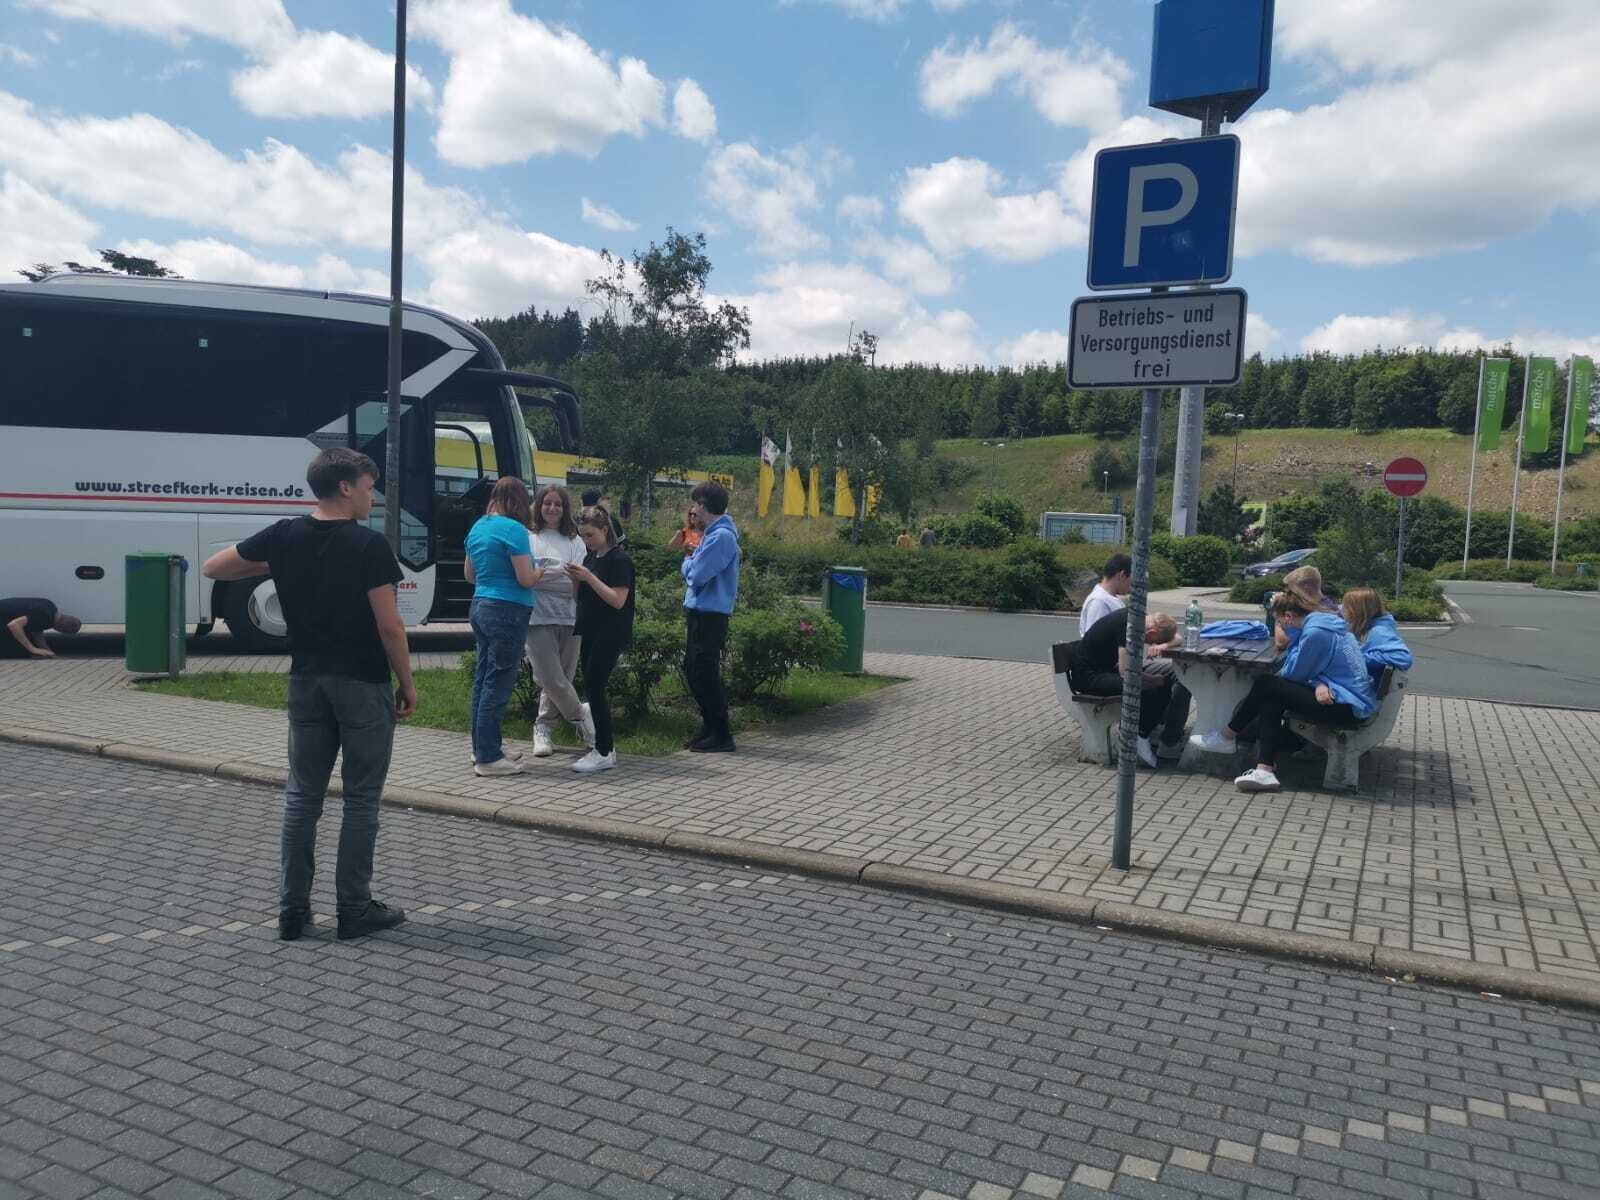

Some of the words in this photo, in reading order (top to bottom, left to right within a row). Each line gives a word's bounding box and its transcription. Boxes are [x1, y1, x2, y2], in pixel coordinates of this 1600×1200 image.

[1122, 163, 1199, 268] P
[1098, 307, 1175, 328] Betriebs-
[1183, 303, 1215, 324] und
[1080, 329, 1233, 356] Versorgungsdienst
[1133, 358, 1171, 378] frei
[75, 480, 304, 498] www.streefkerk-reisen.de
